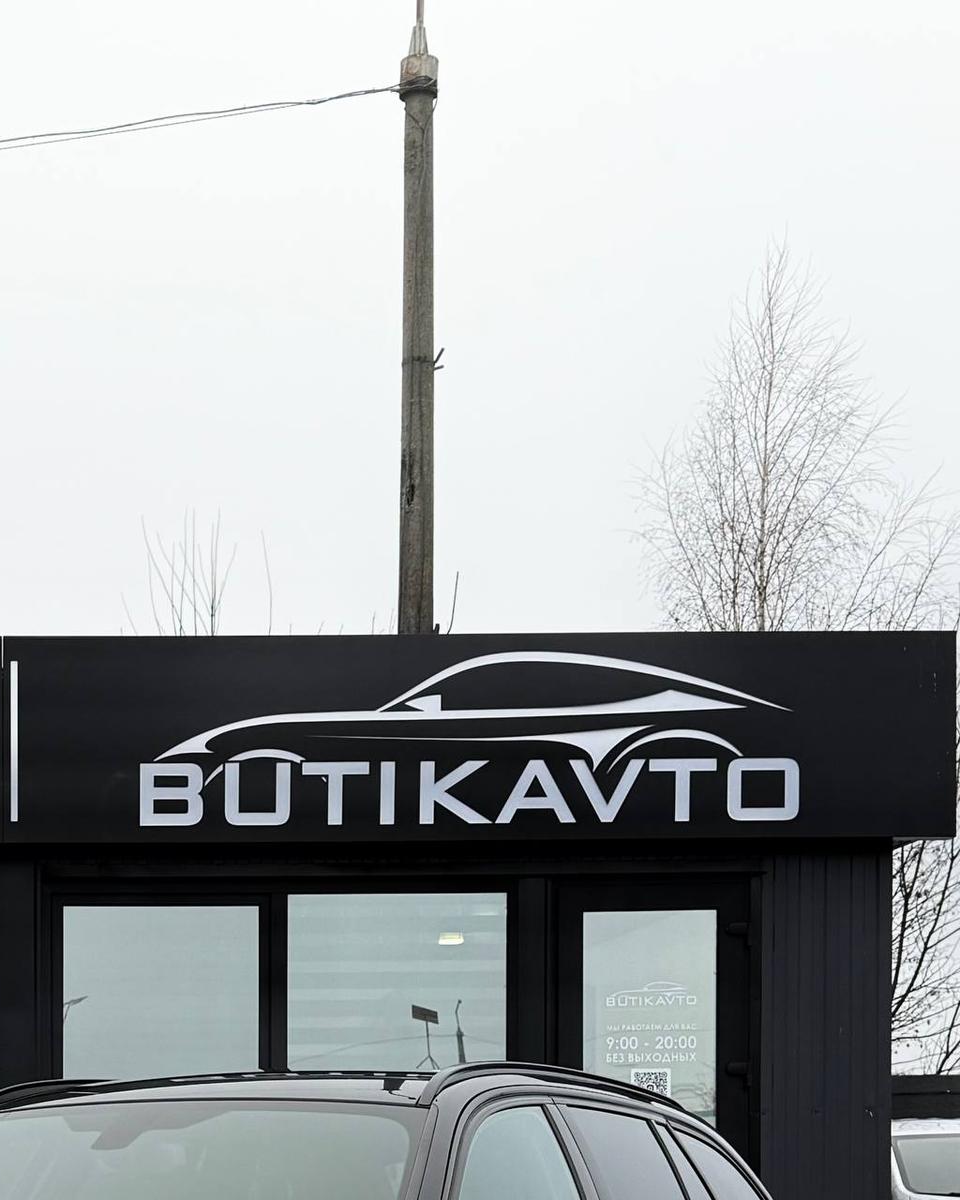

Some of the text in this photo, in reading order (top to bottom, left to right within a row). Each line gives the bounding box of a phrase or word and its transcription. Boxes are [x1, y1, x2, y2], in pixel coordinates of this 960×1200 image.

[139, 756, 800, 827] BUTIKAVTO
[606, 995, 697, 1007] BUTIKAVTO
[606, 1037, 638, 1050] 9:00
[655, 1036, 697, 1049] 20:00
[606, 1053, 697, 1063] БЕЗ ВЫХОДНЫХ
